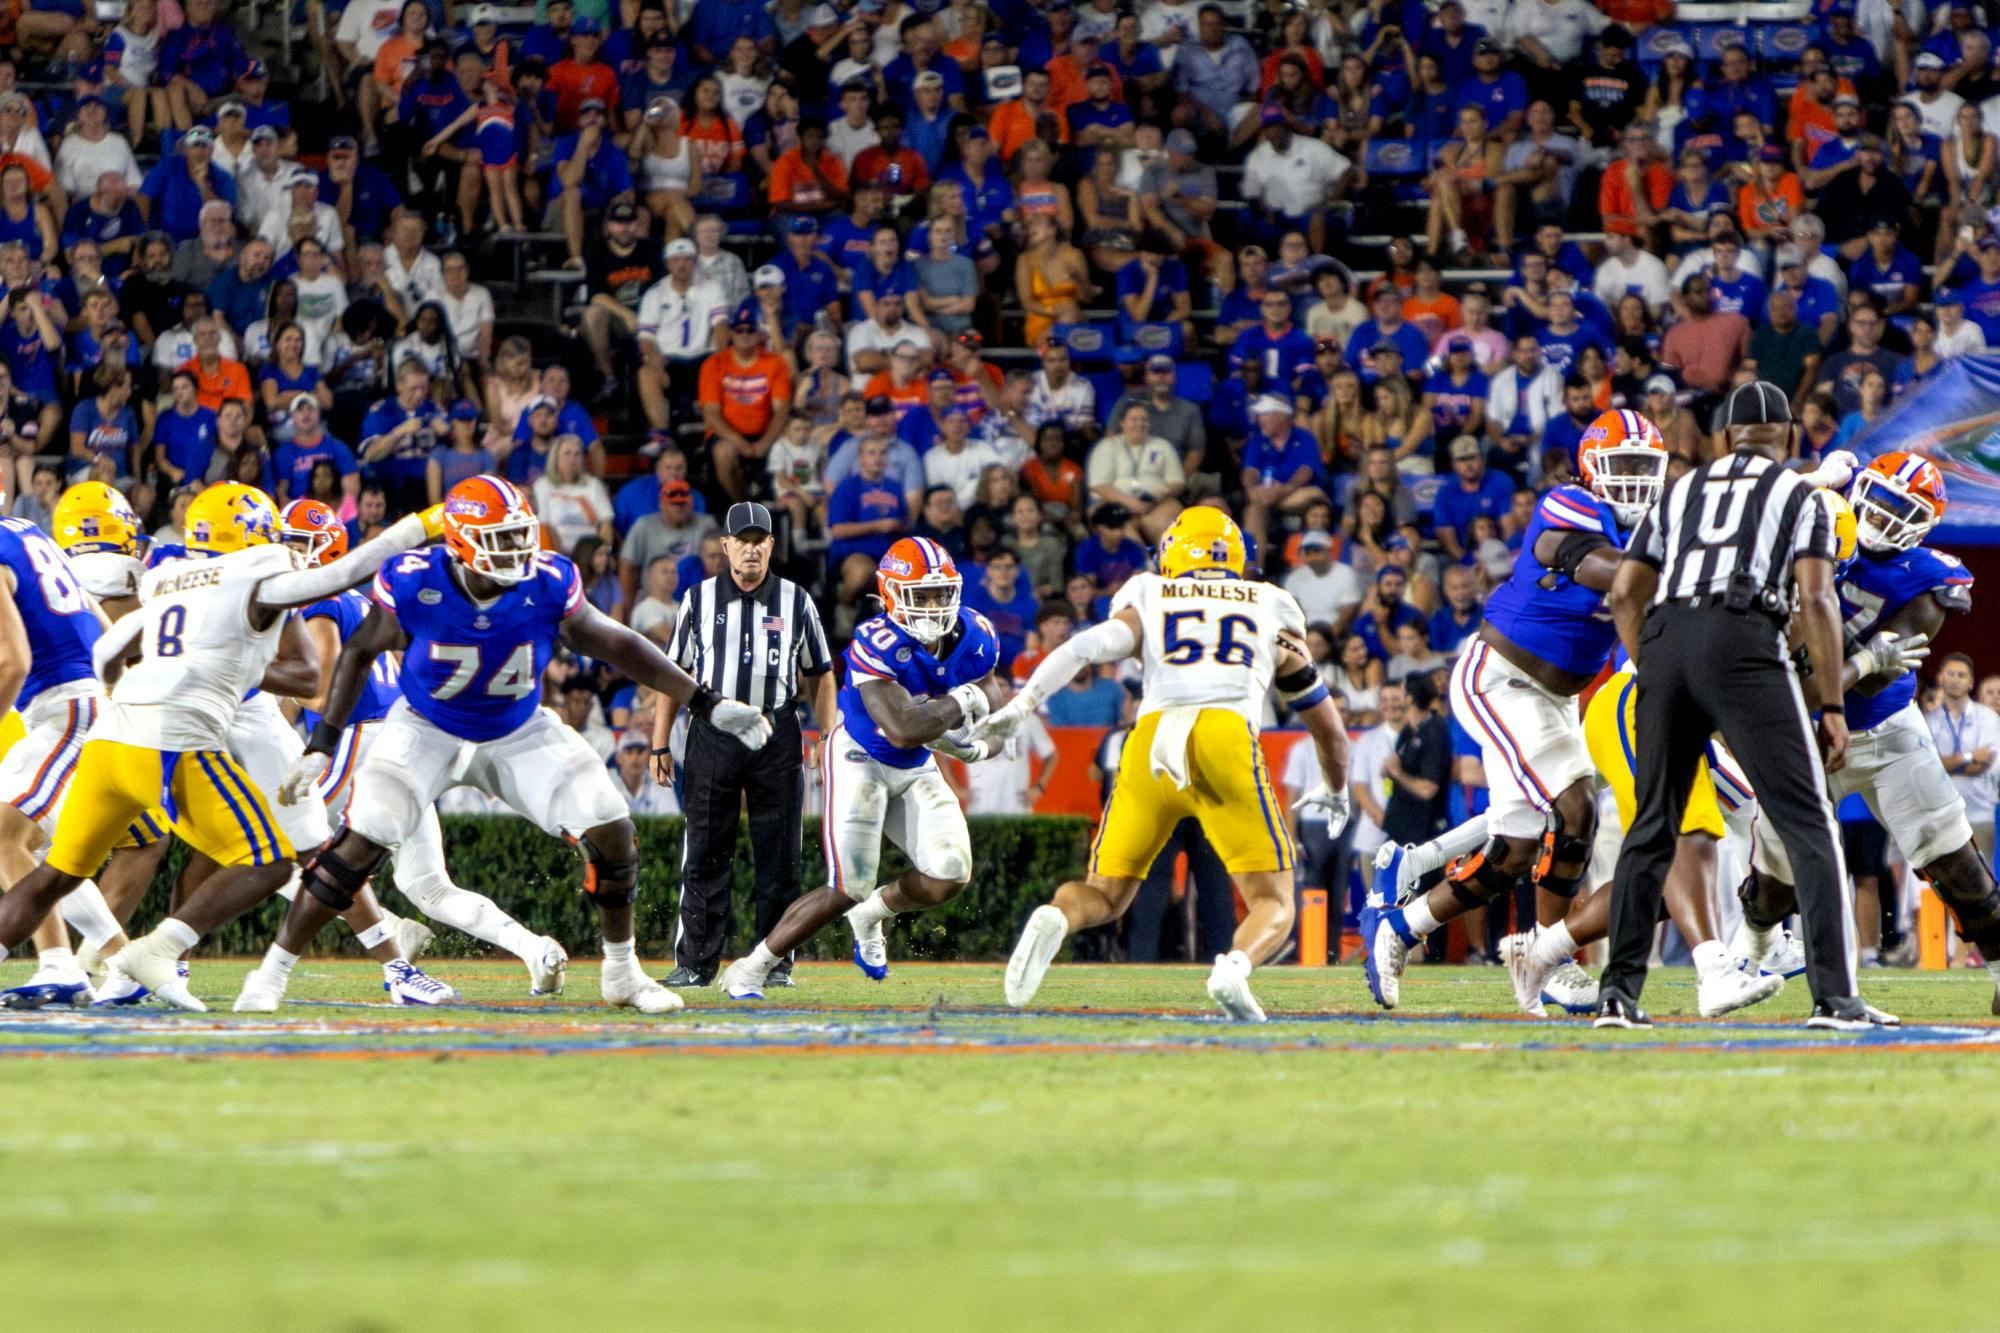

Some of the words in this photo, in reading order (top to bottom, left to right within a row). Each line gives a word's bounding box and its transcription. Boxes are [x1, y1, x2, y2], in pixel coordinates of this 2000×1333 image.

[682, 319, 691, 347] 1
[1267, 348, 1280, 378] 1
[1698, 478, 1758, 545] U
[157, 604, 187, 657] 8
[716, 613, 726, 625] S
[856, 618, 899, 651] 20
[1161, 609, 1259, 668] 56
[429, 639, 537, 702] 74
[768, 648, 780, 666] C
